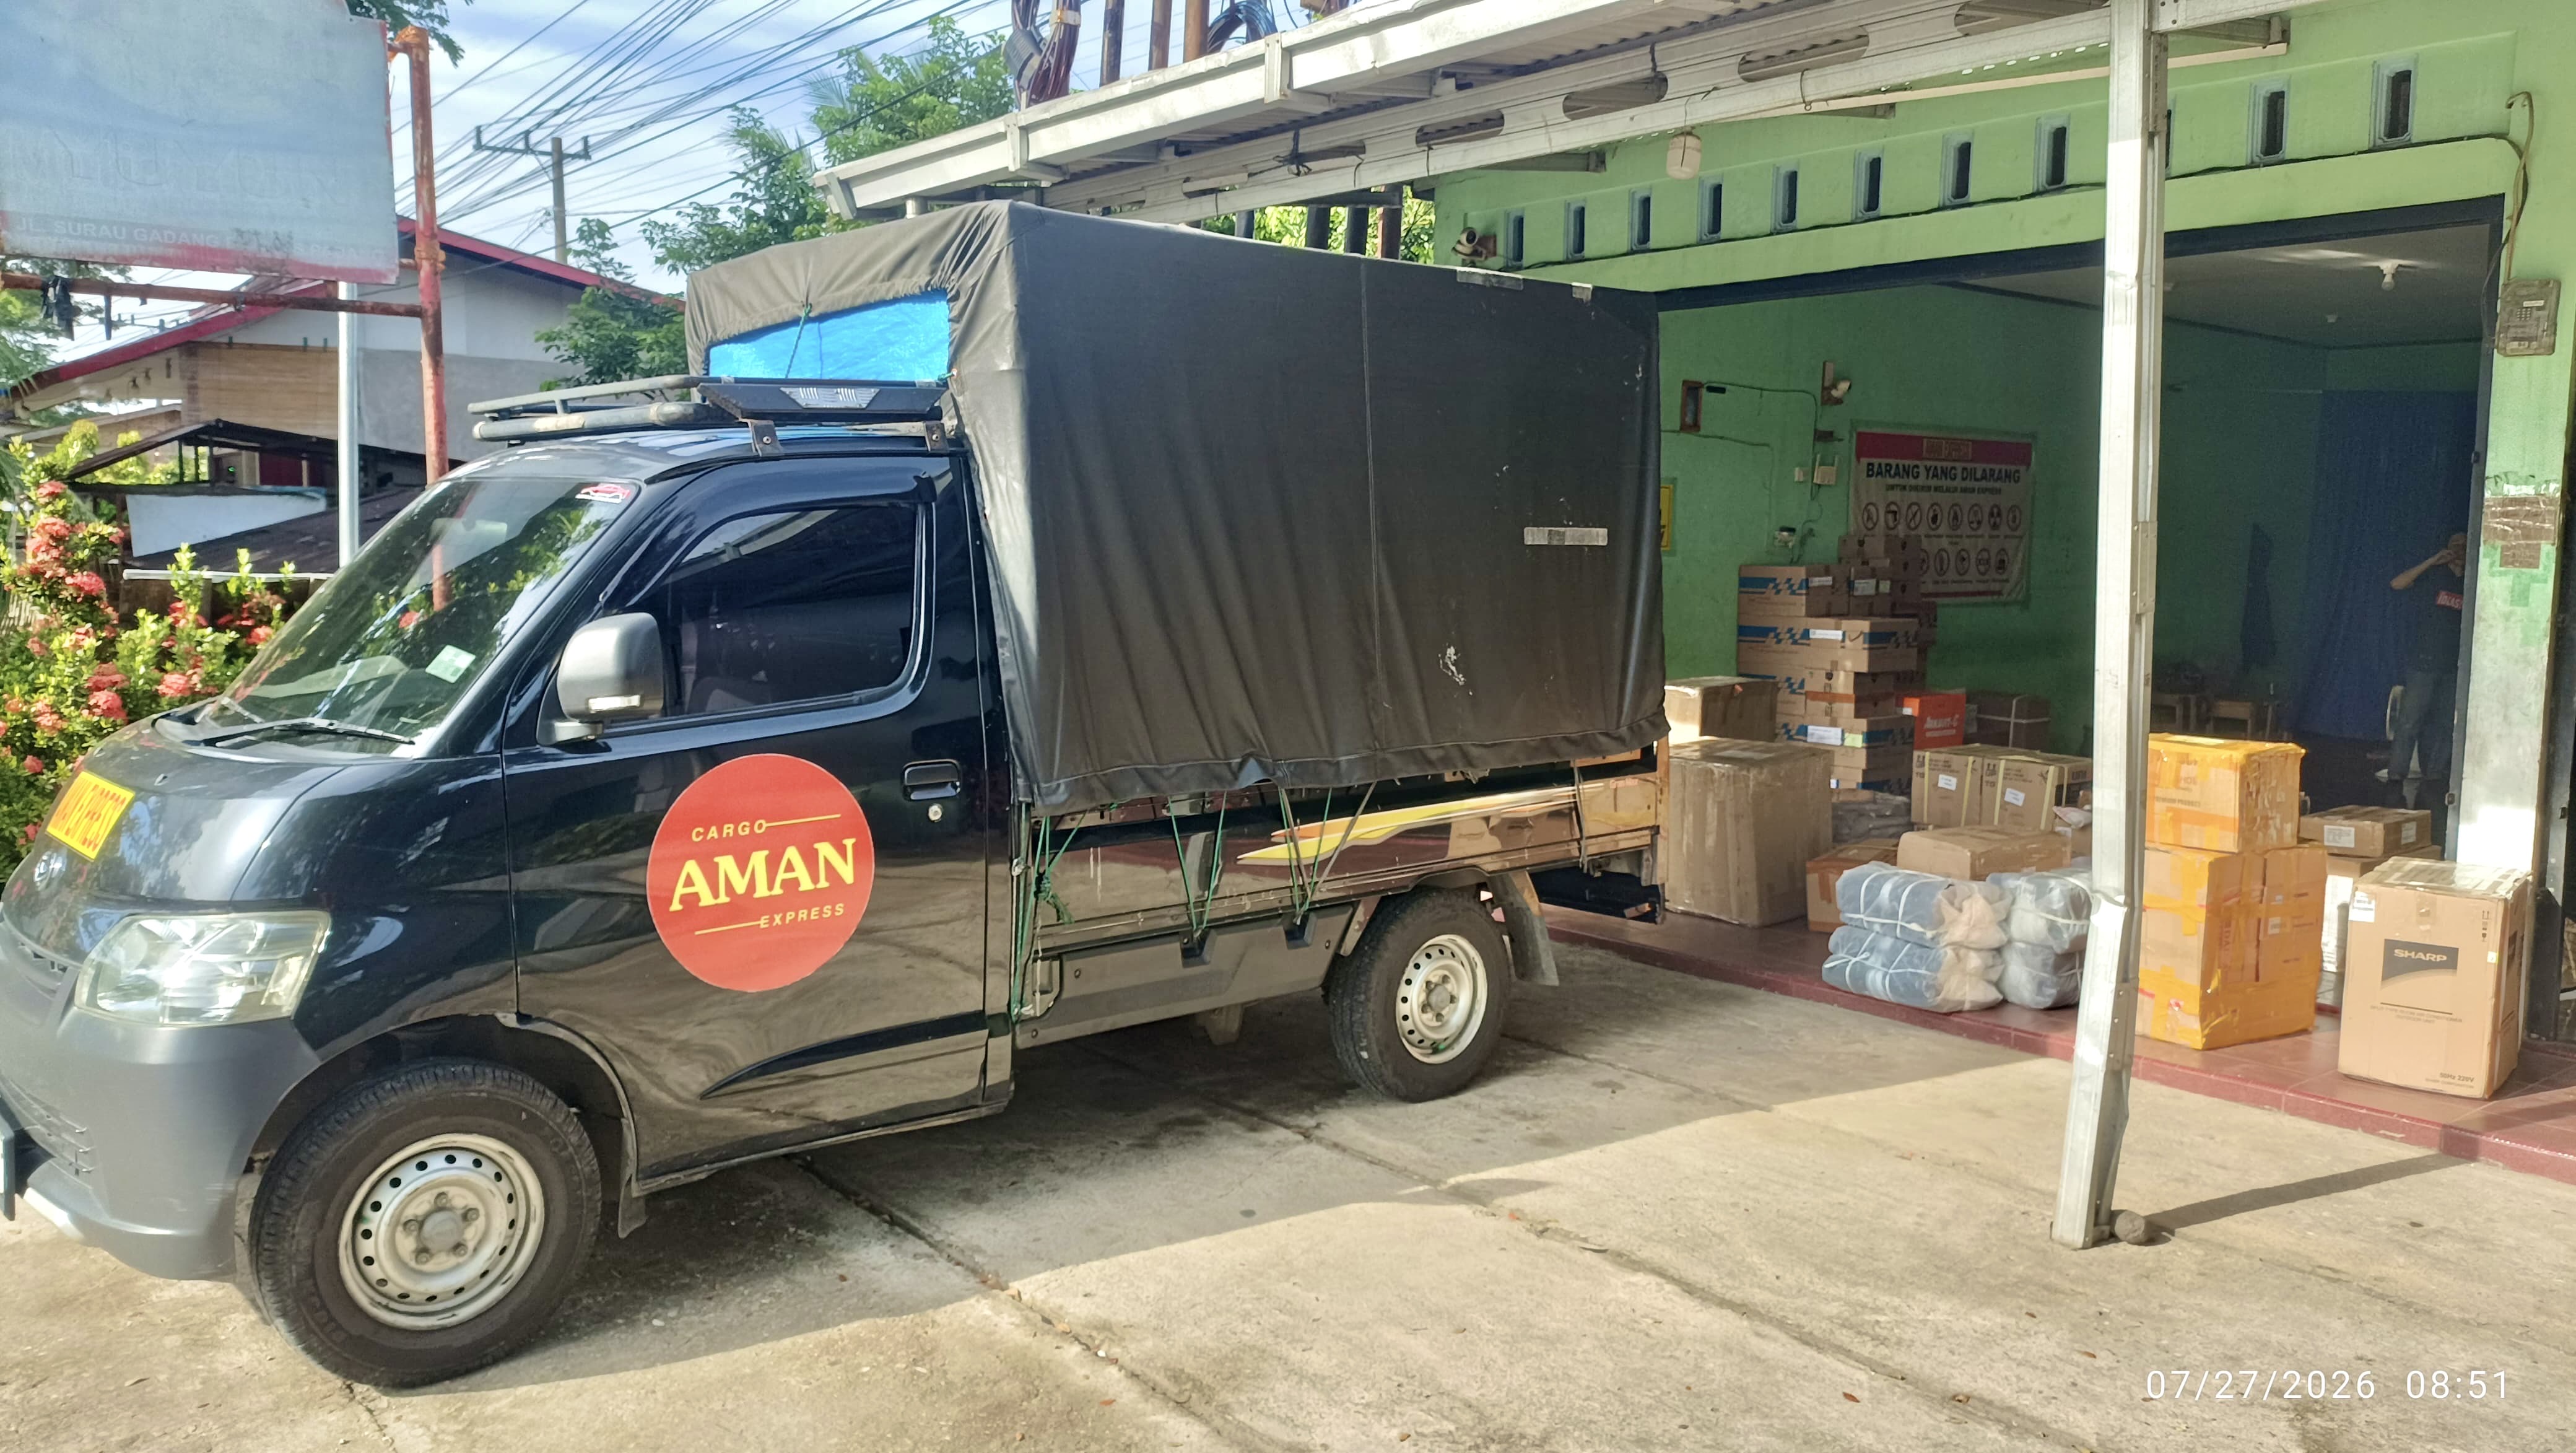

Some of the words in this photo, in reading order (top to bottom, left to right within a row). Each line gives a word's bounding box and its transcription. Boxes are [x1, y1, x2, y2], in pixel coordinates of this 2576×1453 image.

[54, 219, 126, 240] SURAU
[133, 227, 219, 247] GADANG
[1866, 462, 1920, 479] BARANG
[1924, 465, 1957, 481] YANG
[1961, 466, 2021, 484] DILARANG
[692, 819, 767, 842] CARGO
[669, 837, 856, 912] AMAN
[760, 903, 845, 928] EXPRESS
[2394, 949, 2448, 962] SHARP
